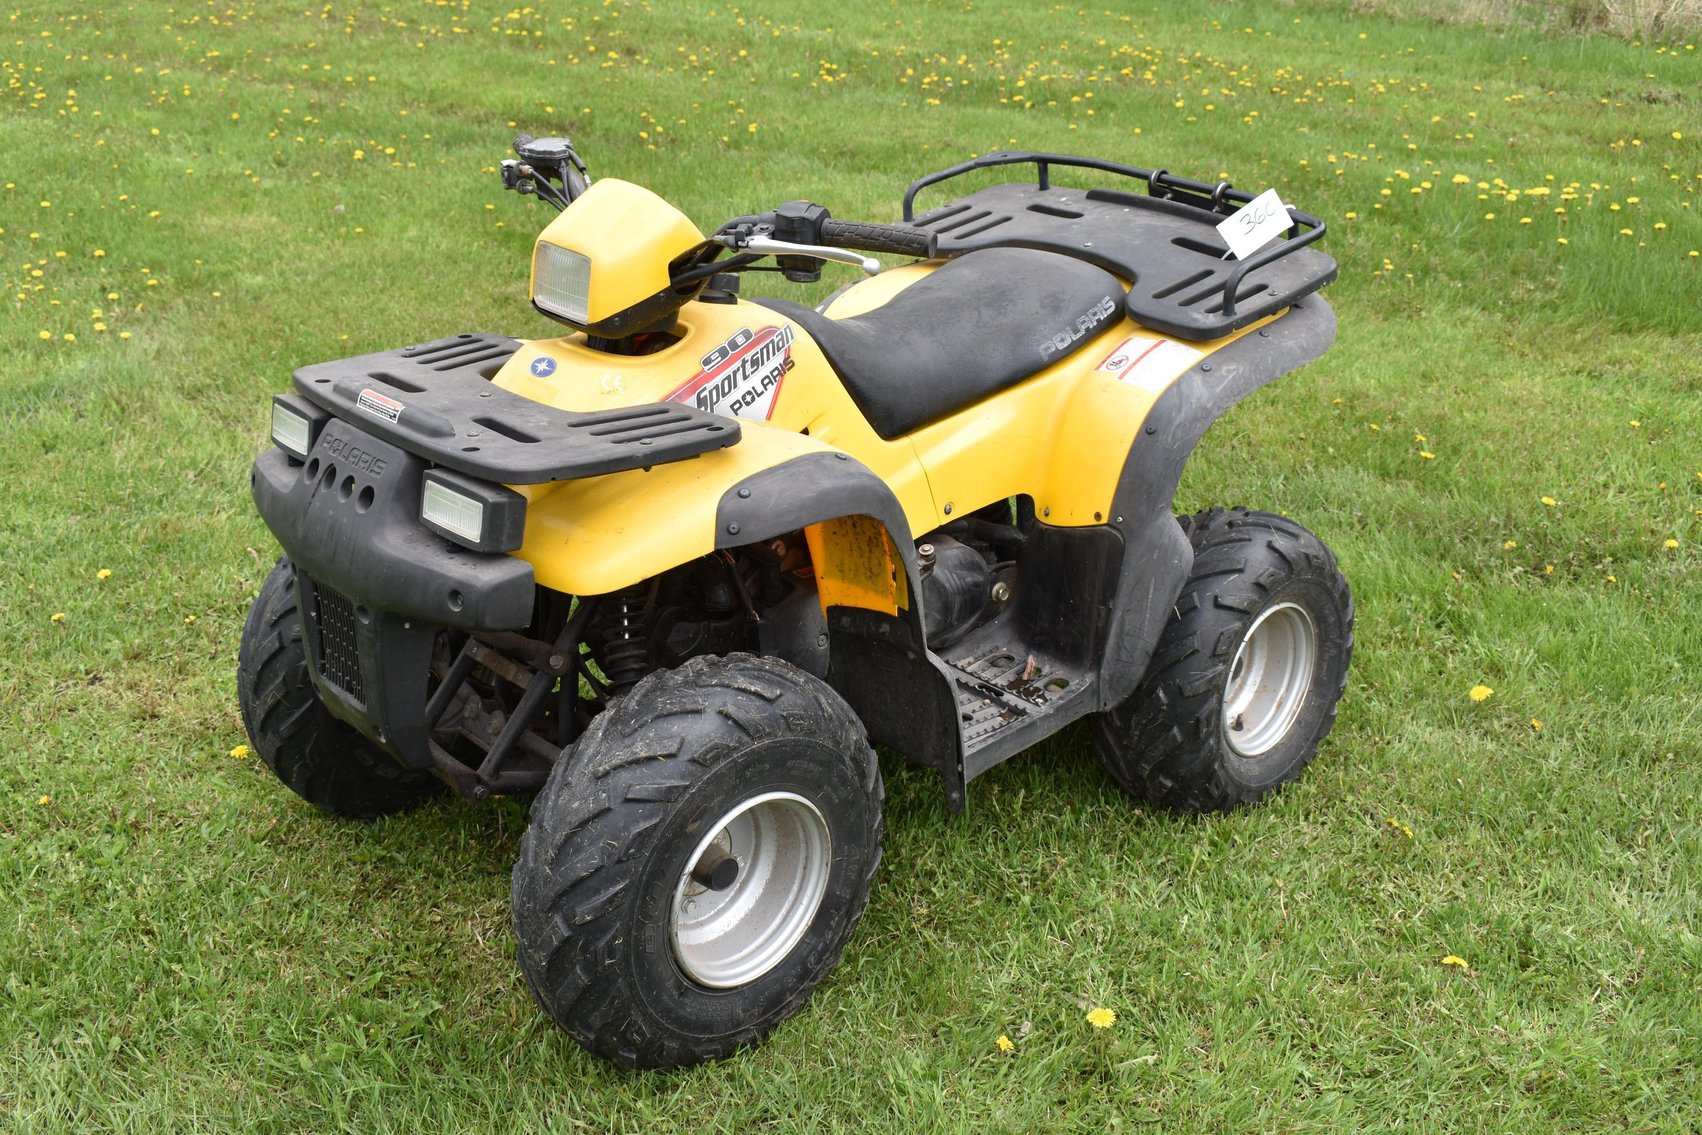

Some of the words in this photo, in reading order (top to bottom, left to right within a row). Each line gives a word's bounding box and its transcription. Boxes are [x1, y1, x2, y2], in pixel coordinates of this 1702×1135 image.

[701, 326, 754, 372] 90
[1039, 295, 1116, 362] POLARIS
[696, 324, 795, 414] Sportsman
[729, 355, 796, 416] POLARIS
[320, 433, 388, 478] POLARIS
